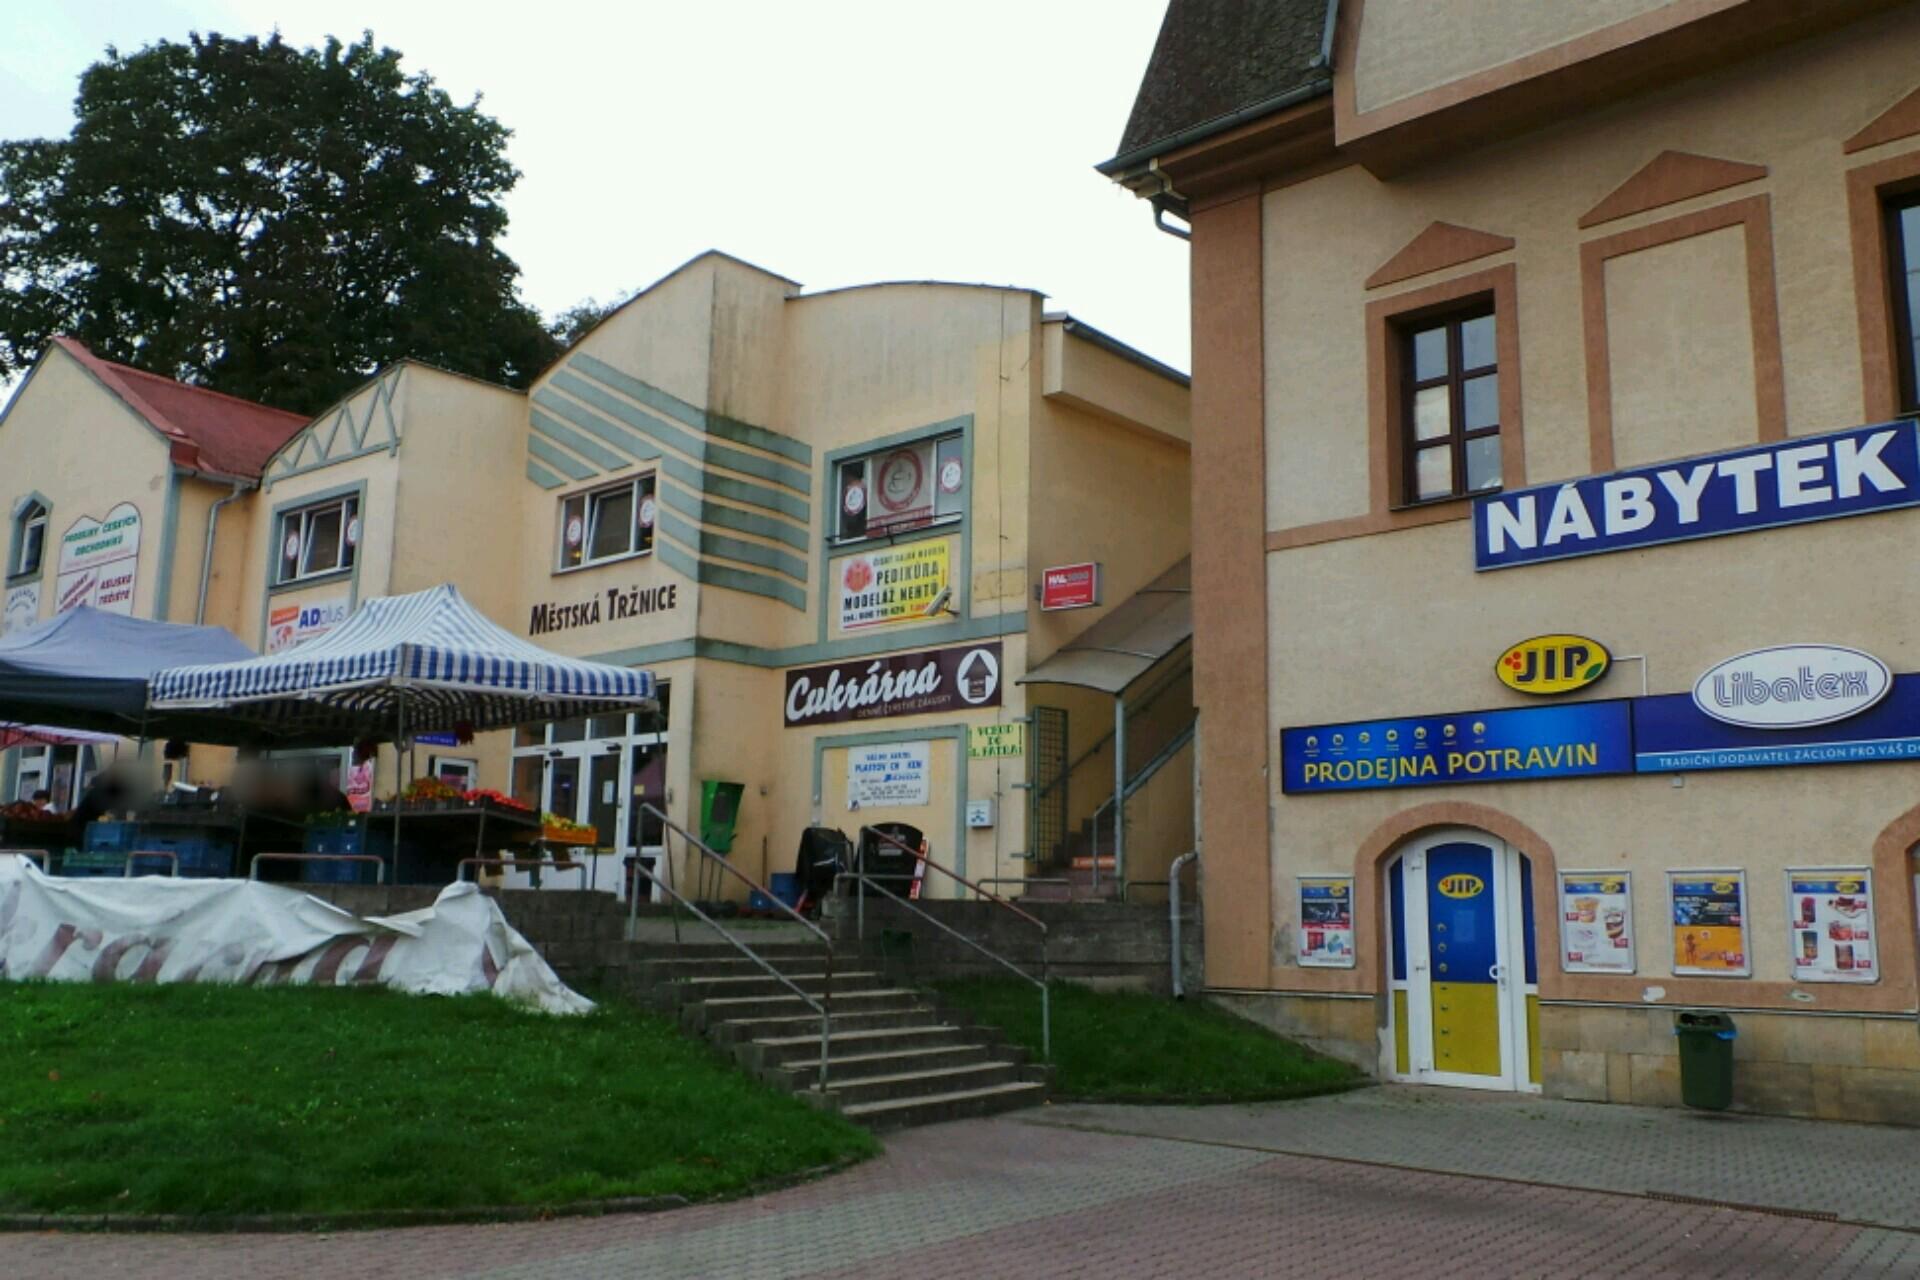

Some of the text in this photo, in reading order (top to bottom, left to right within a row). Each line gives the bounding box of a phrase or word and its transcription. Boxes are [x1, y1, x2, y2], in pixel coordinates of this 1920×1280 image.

[1487, 430, 1906, 554] NÁBYTEK
[529, 584, 676, 636] MĚSTSKÁ TRŽNICE
[1517, 645, 1590, 683] JIP
[786, 660, 942, 722] Cukrárna
[1713, 666, 1869, 708] Libatex
[1304, 754, 1438, 783] PRODEJNA
[1448, 743, 1598, 775] POTRAVIN
[1660, 751, 1716, 768] TRADIČNÍ
[1718, 751, 1791, 764] DODAVATEL
[1850, 745, 1876, 757] PRO
[1878, 741, 1904, 755] VÁŠ
[1447, 878, 1477, 894] JIP
